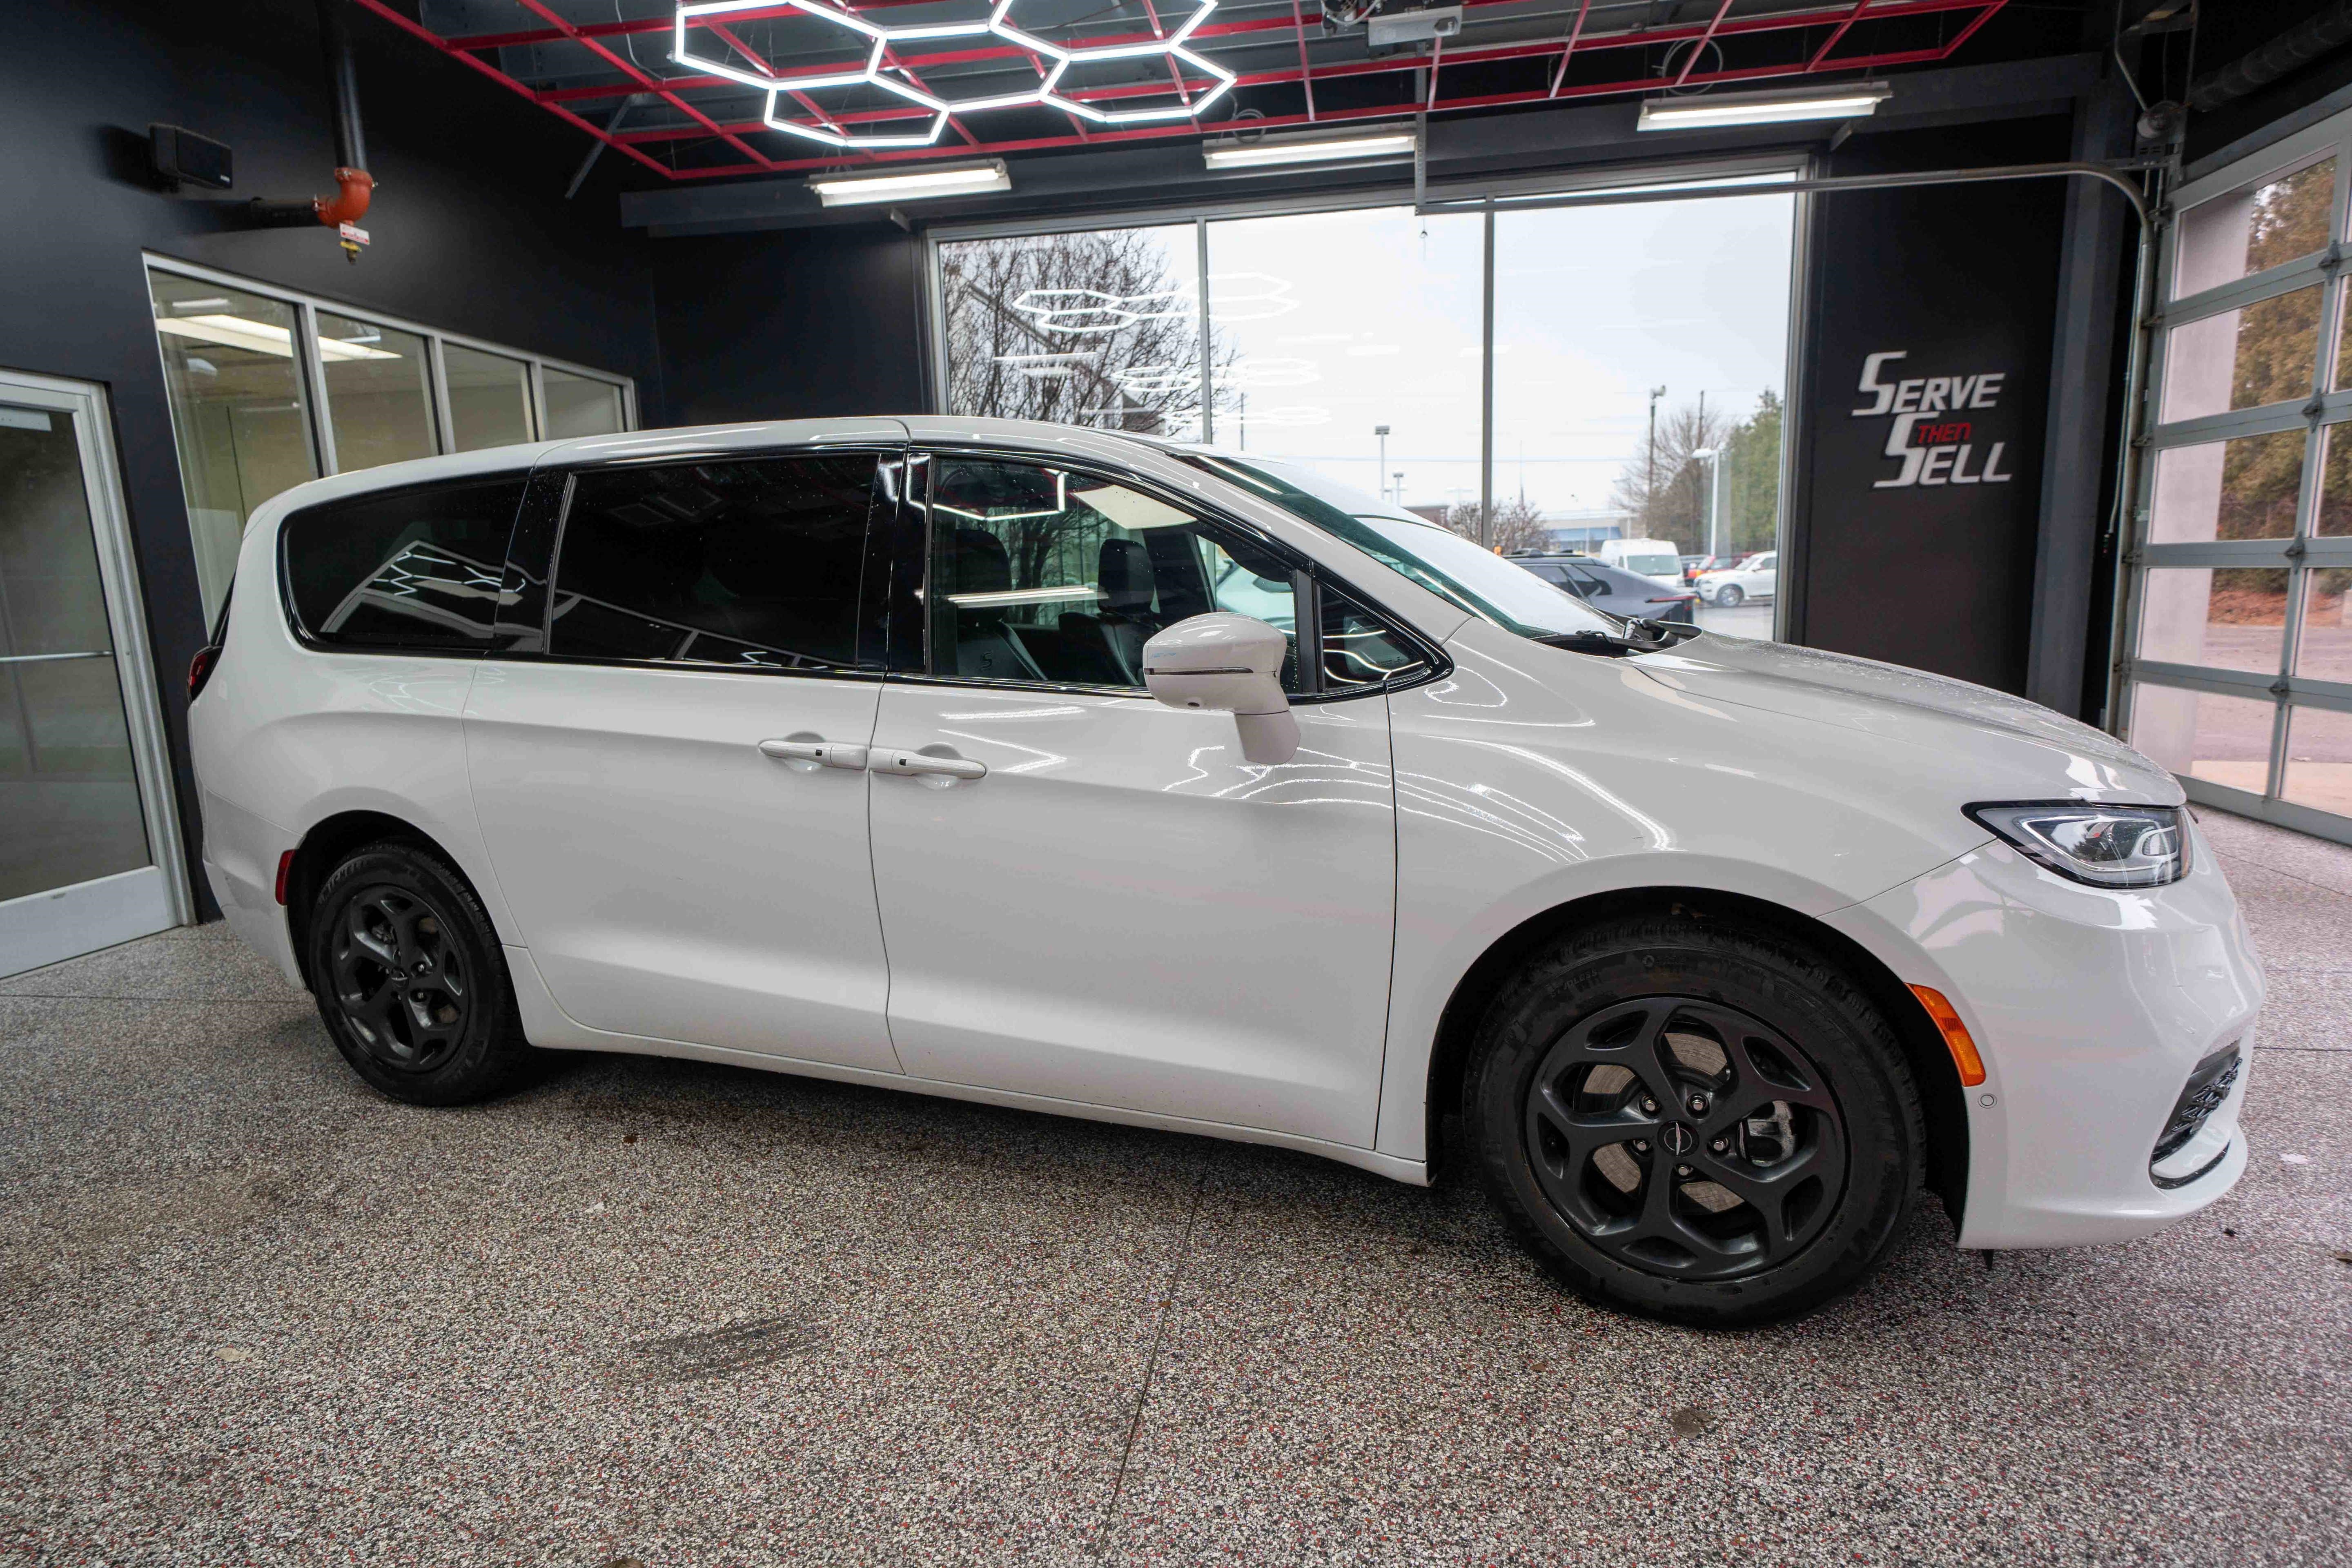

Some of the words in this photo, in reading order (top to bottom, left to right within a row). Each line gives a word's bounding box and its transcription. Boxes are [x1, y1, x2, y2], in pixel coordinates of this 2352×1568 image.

[1851, 351, 2005, 416] SERVE
[1873, 411, 2011, 488] SELL
[1918, 422, 1971, 444] THEN
